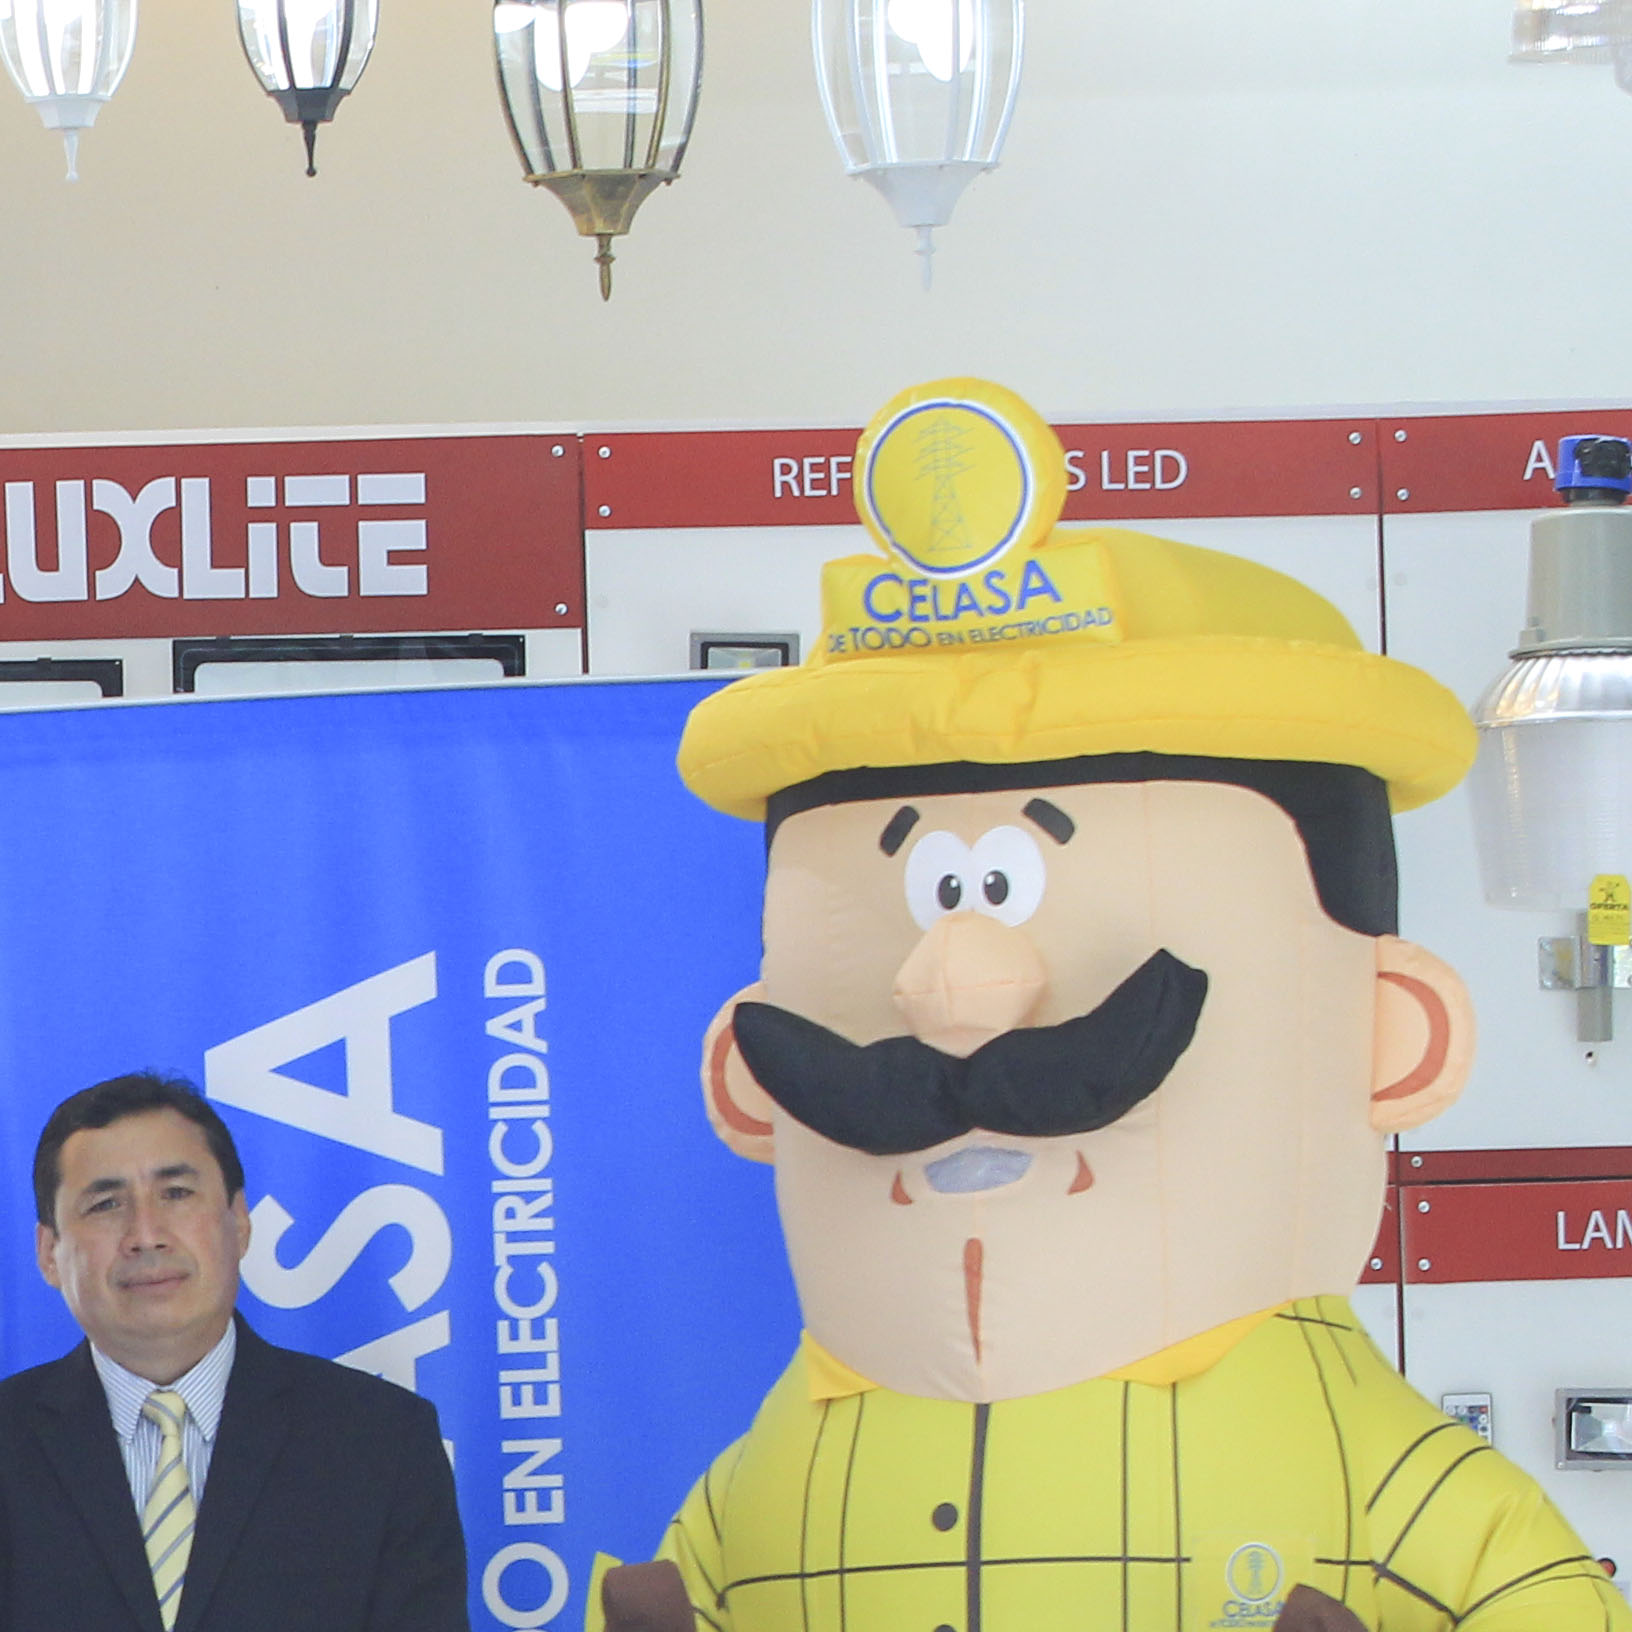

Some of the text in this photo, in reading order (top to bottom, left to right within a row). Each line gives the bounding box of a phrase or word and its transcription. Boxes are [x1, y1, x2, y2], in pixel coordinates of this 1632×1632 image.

[1100, 448, 1189, 492] LED
[863, 559, 1063, 624] CELASA
[849, 626, 932, 651] TODO
[937, 630, 965, 646] EN
[970, 606, 1114, 644] ELECTRICIDAD
[484, 946, 562, 1420] ELECTRICIDAD
[504, 1436, 566, 1525] EN
